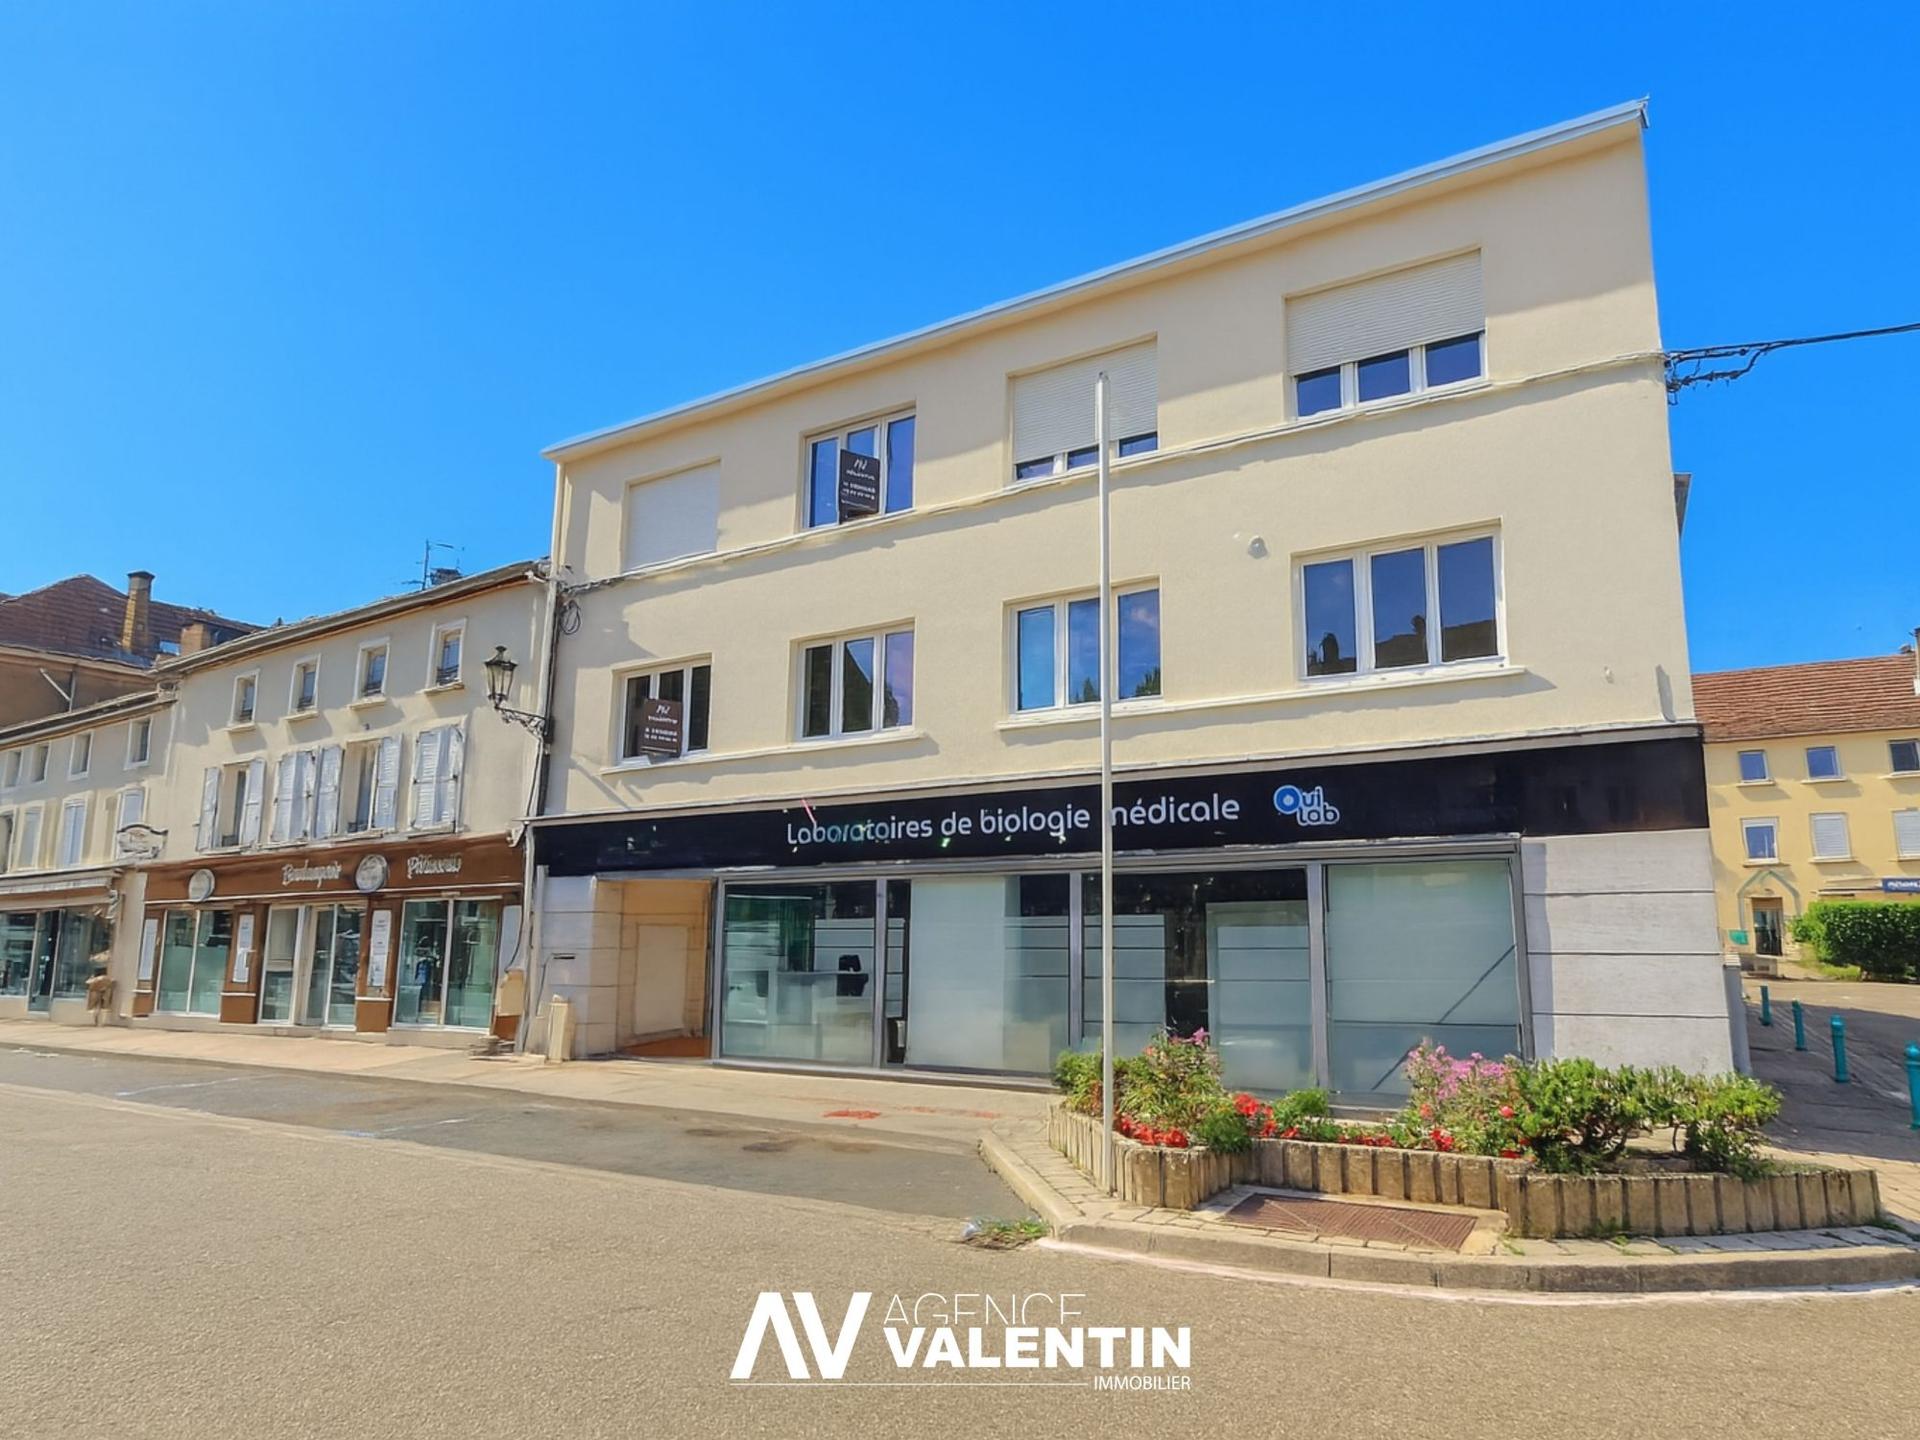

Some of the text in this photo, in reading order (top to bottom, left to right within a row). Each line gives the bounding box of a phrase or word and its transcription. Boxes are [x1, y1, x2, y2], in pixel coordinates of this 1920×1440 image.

[787, 815, 933, 845] Laboratoires
[940, 811, 973, 836] de
[980, 803, 1090, 837] biologie
